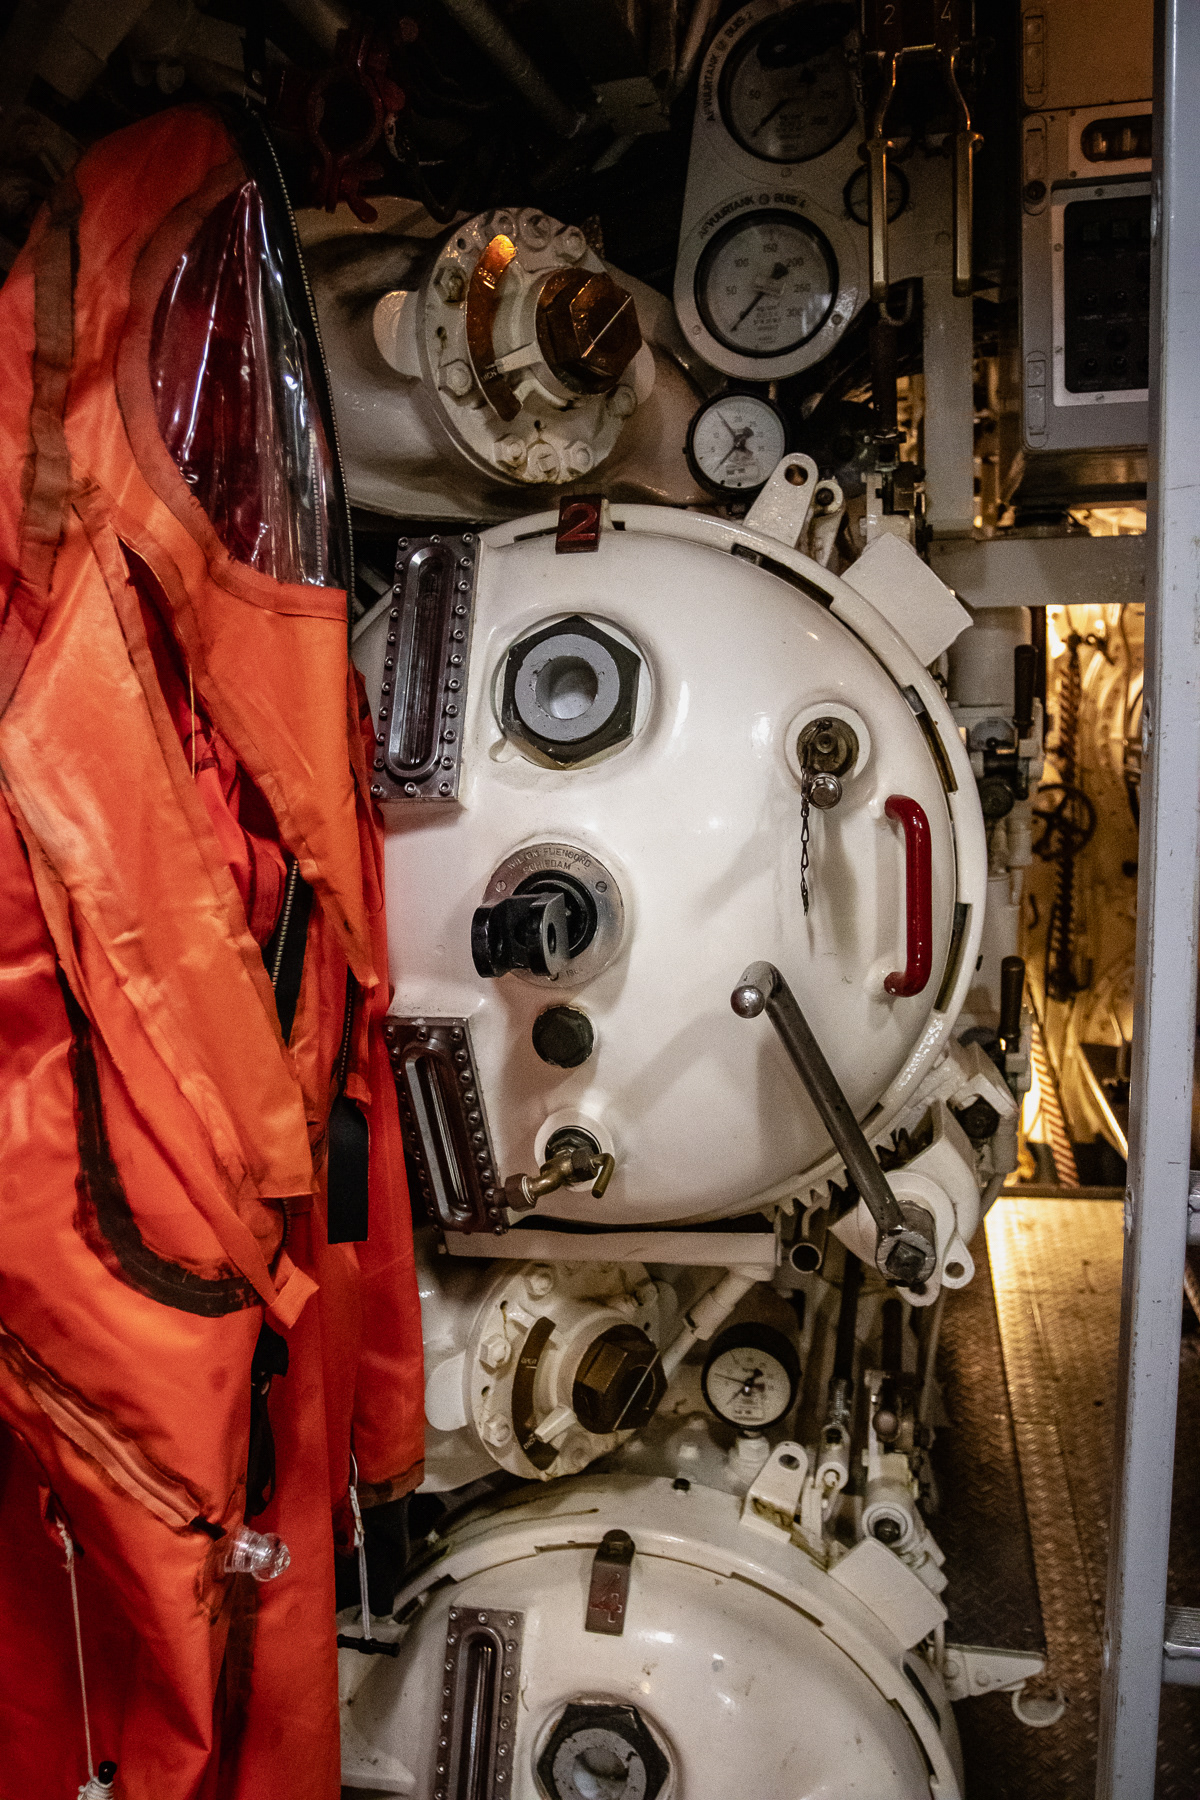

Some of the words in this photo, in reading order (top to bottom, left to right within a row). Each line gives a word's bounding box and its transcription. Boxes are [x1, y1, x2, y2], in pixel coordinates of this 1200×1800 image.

[883, 4, 896, 25] 2
[940, 0, 951, 20] 4
[703, 53, 718, 121] AFVUURTANK
[774, 192, 798, 206] BUIS
[763, 243, 778, 253] 150
[786, 256, 804, 267] 200
[478, 267, 497, 285] OPEN
[726, 285, 737, 295] 50
[793, 283, 811, 293] 250
[557, 502, 598, 542] 2
[588, 1573, 623, 1624] 4
